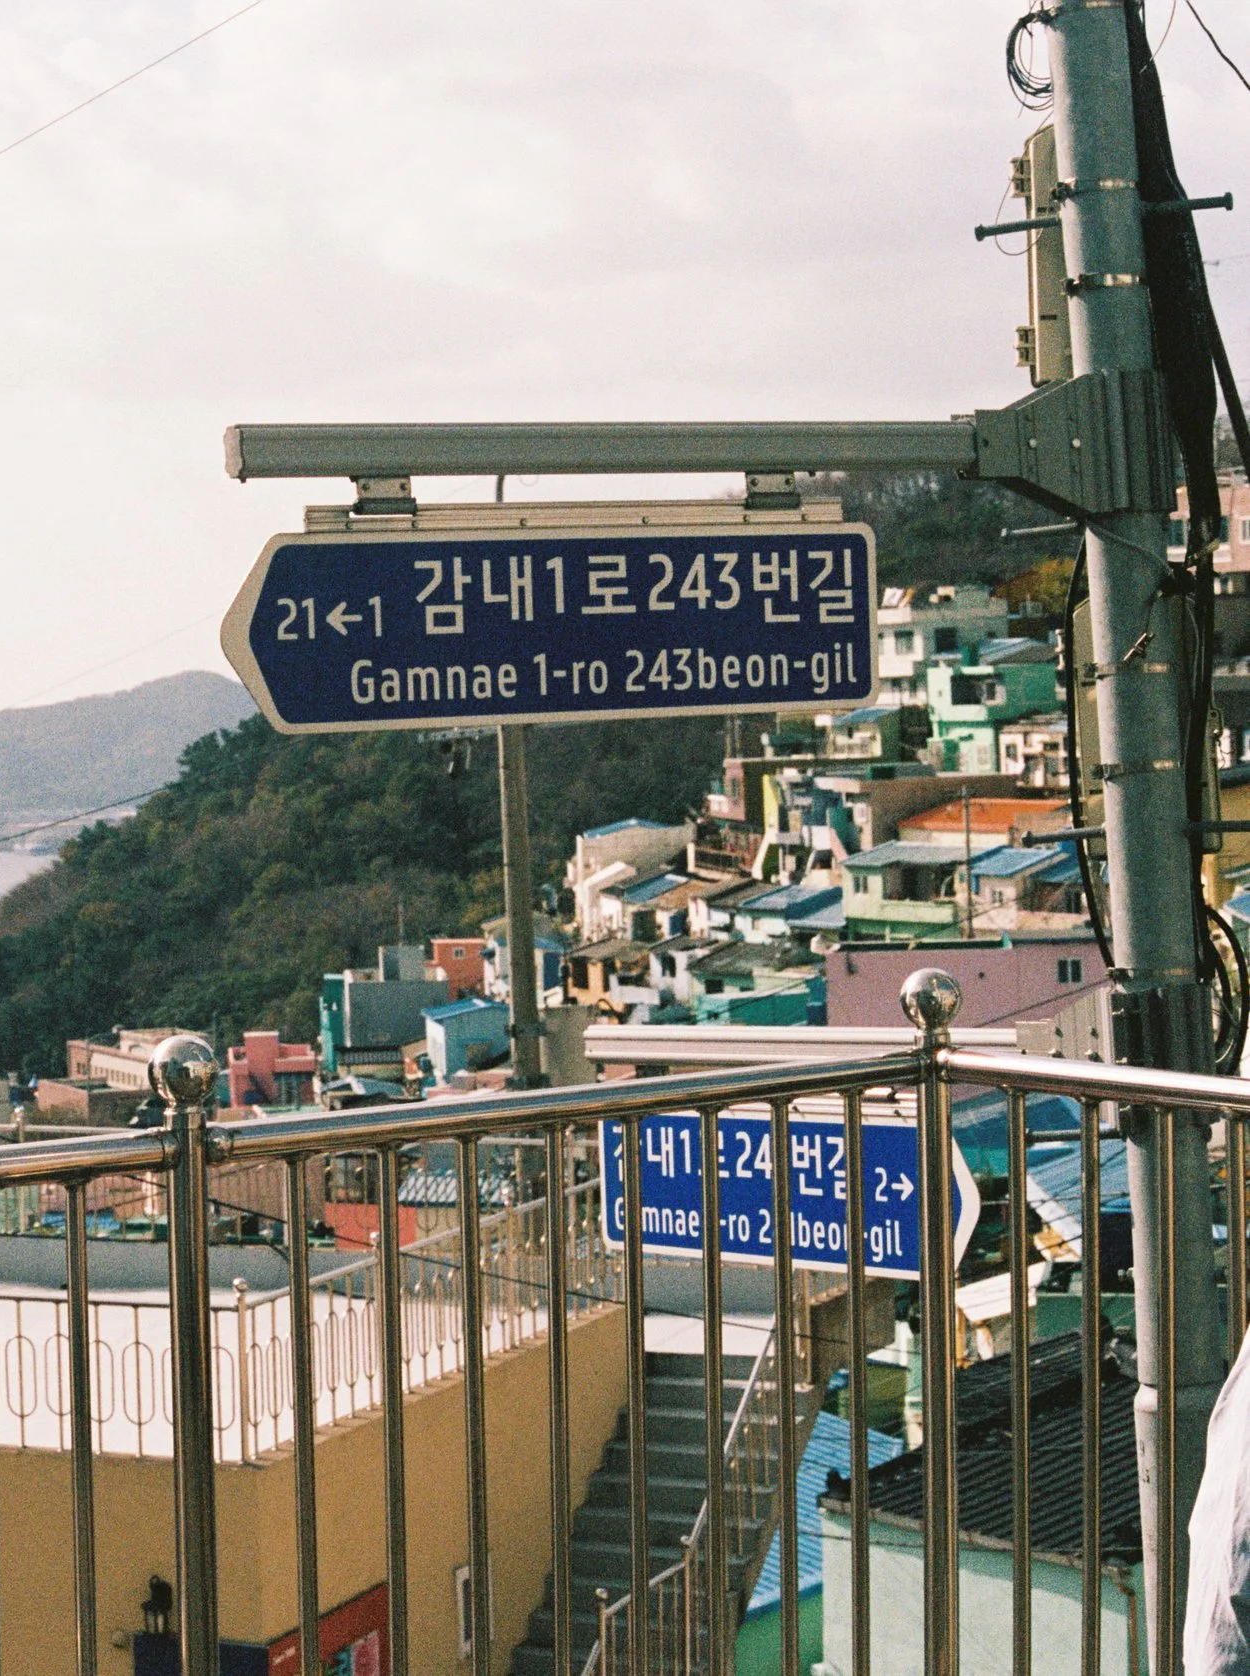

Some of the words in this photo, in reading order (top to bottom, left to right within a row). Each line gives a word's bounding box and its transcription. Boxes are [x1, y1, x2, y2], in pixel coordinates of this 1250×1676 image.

[277, 597, 316, 640] 21
[350, 659, 518, 704] Gamnae
[533, 653, 609, 696] 1-ro
[625, 643, 857, 695] 243beon-gil
[614, 1197, 700, 1237] Gmnae
[716, 1214, 751, 1242] -ro
[758, 1208, 903, 1263] 2beo-gil
